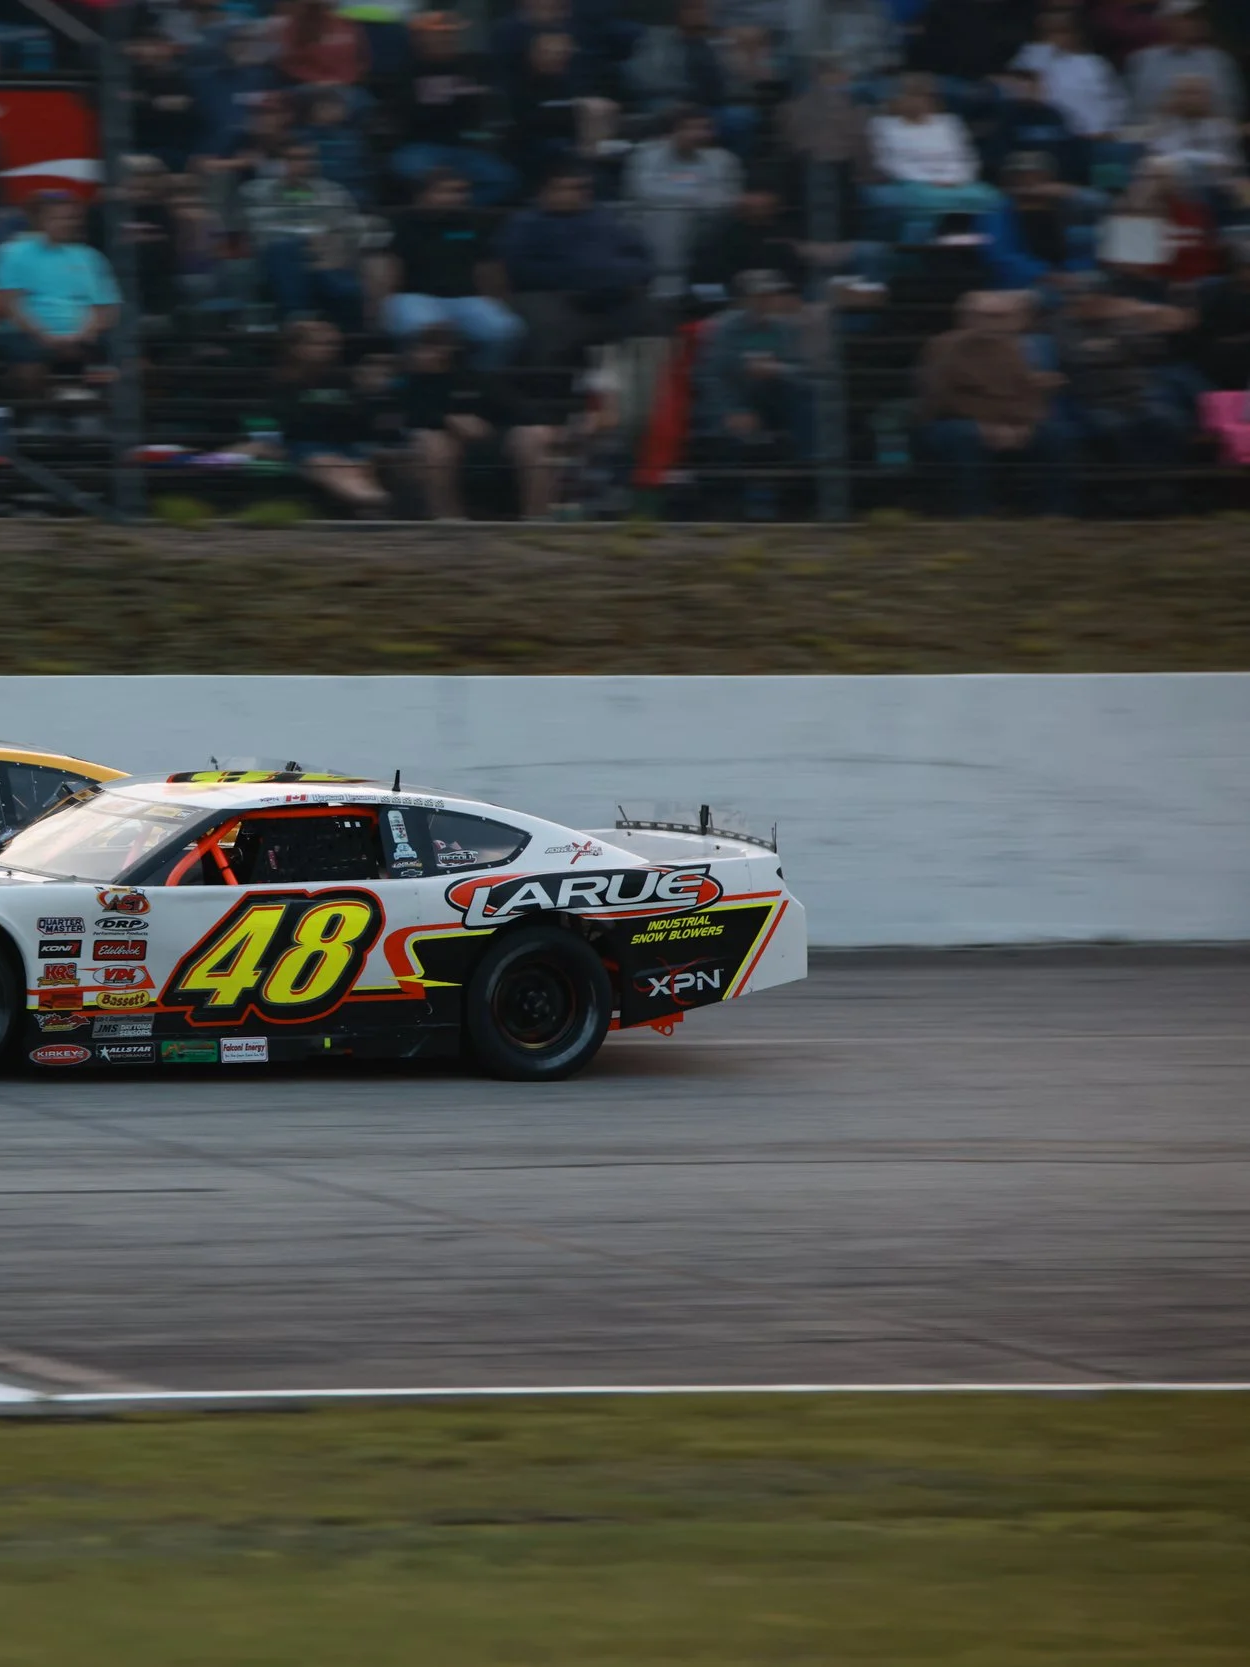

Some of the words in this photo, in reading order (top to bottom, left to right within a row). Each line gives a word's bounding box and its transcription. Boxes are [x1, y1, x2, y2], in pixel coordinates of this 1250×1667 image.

[464, 866, 709, 928] LARUE
[38, 919, 82, 929] QUARTER
[45, 925, 84, 933] MASTER
[102, 919, 142, 928] DRP
[646, 915, 711, 931] INDUSTRIAL
[630, 931, 667, 944] SNOW
[668, 925, 724, 940] BLOWERS
[98, 943, 141, 956] Edelbrock
[174, 898, 374, 1008] 48
[44, 963, 76, 980] KRC
[648, 968, 721, 997] XPN
[101, 992, 146, 1006] Bassett
[95, 1024, 119, 1033] JMS
[37, 1050, 80, 1058] KIRKEY
[224, 1043, 244, 1051] Falconi
[245, 1043, 265, 1052] Energy
